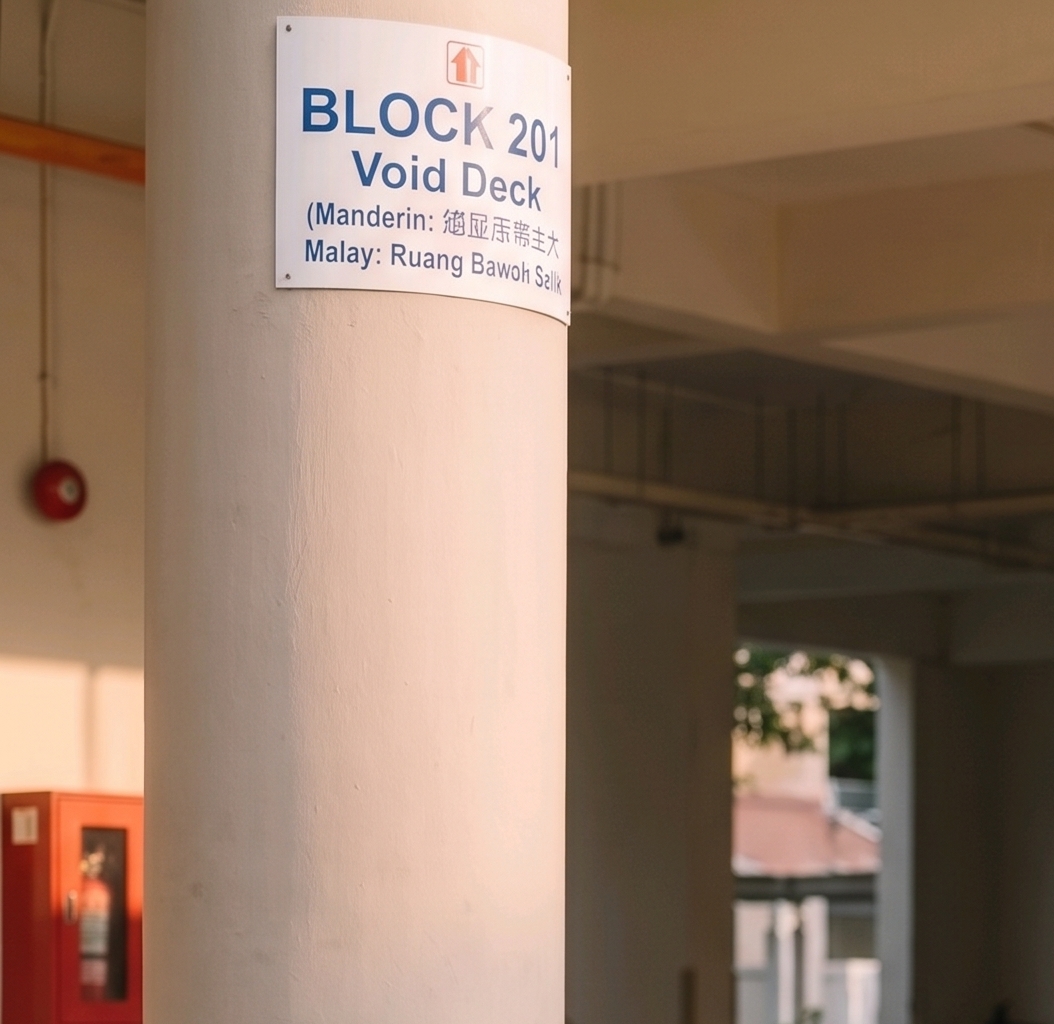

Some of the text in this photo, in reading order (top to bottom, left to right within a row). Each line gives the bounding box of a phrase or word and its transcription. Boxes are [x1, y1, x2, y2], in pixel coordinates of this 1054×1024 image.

[302, 87, 559, 169] BLOCK 201
[351, 150, 541, 212] Void Deck
[307, 201, 434, 232] (Manderin:
[305, 239, 381, 270] Malay:
[391, 243, 463, 278] Ruang
